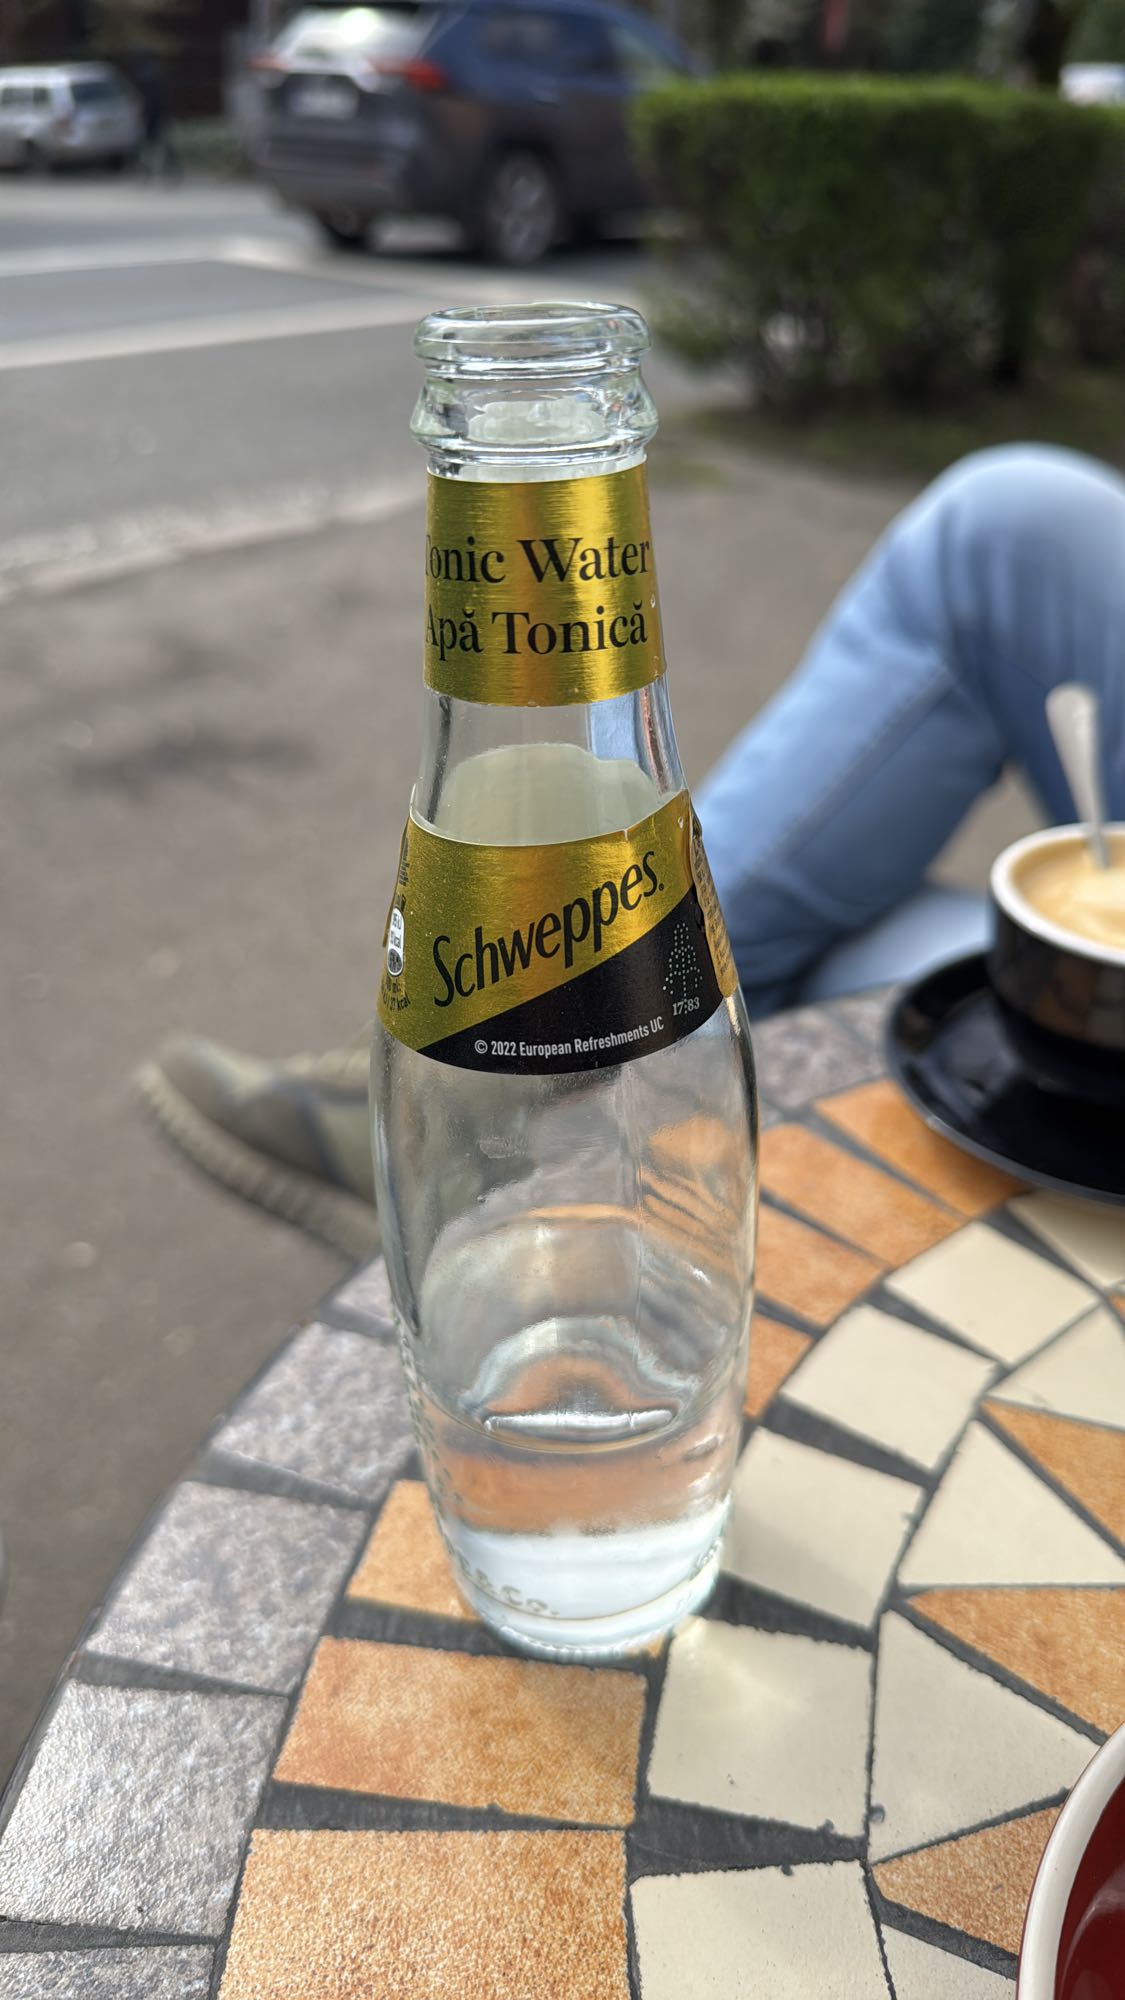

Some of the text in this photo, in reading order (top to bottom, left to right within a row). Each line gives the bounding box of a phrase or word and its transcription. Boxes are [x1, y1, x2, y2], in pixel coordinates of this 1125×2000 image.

[517, 537, 650, 583] Water
[425, 600, 648, 662] Apă Tonică
[491, 1041, 517, 1056] 2022
[520, 1042, 571, 1059] European
[574, 1025, 649, 1051] Refreshments
[650, 1016, 664, 1033] UC
